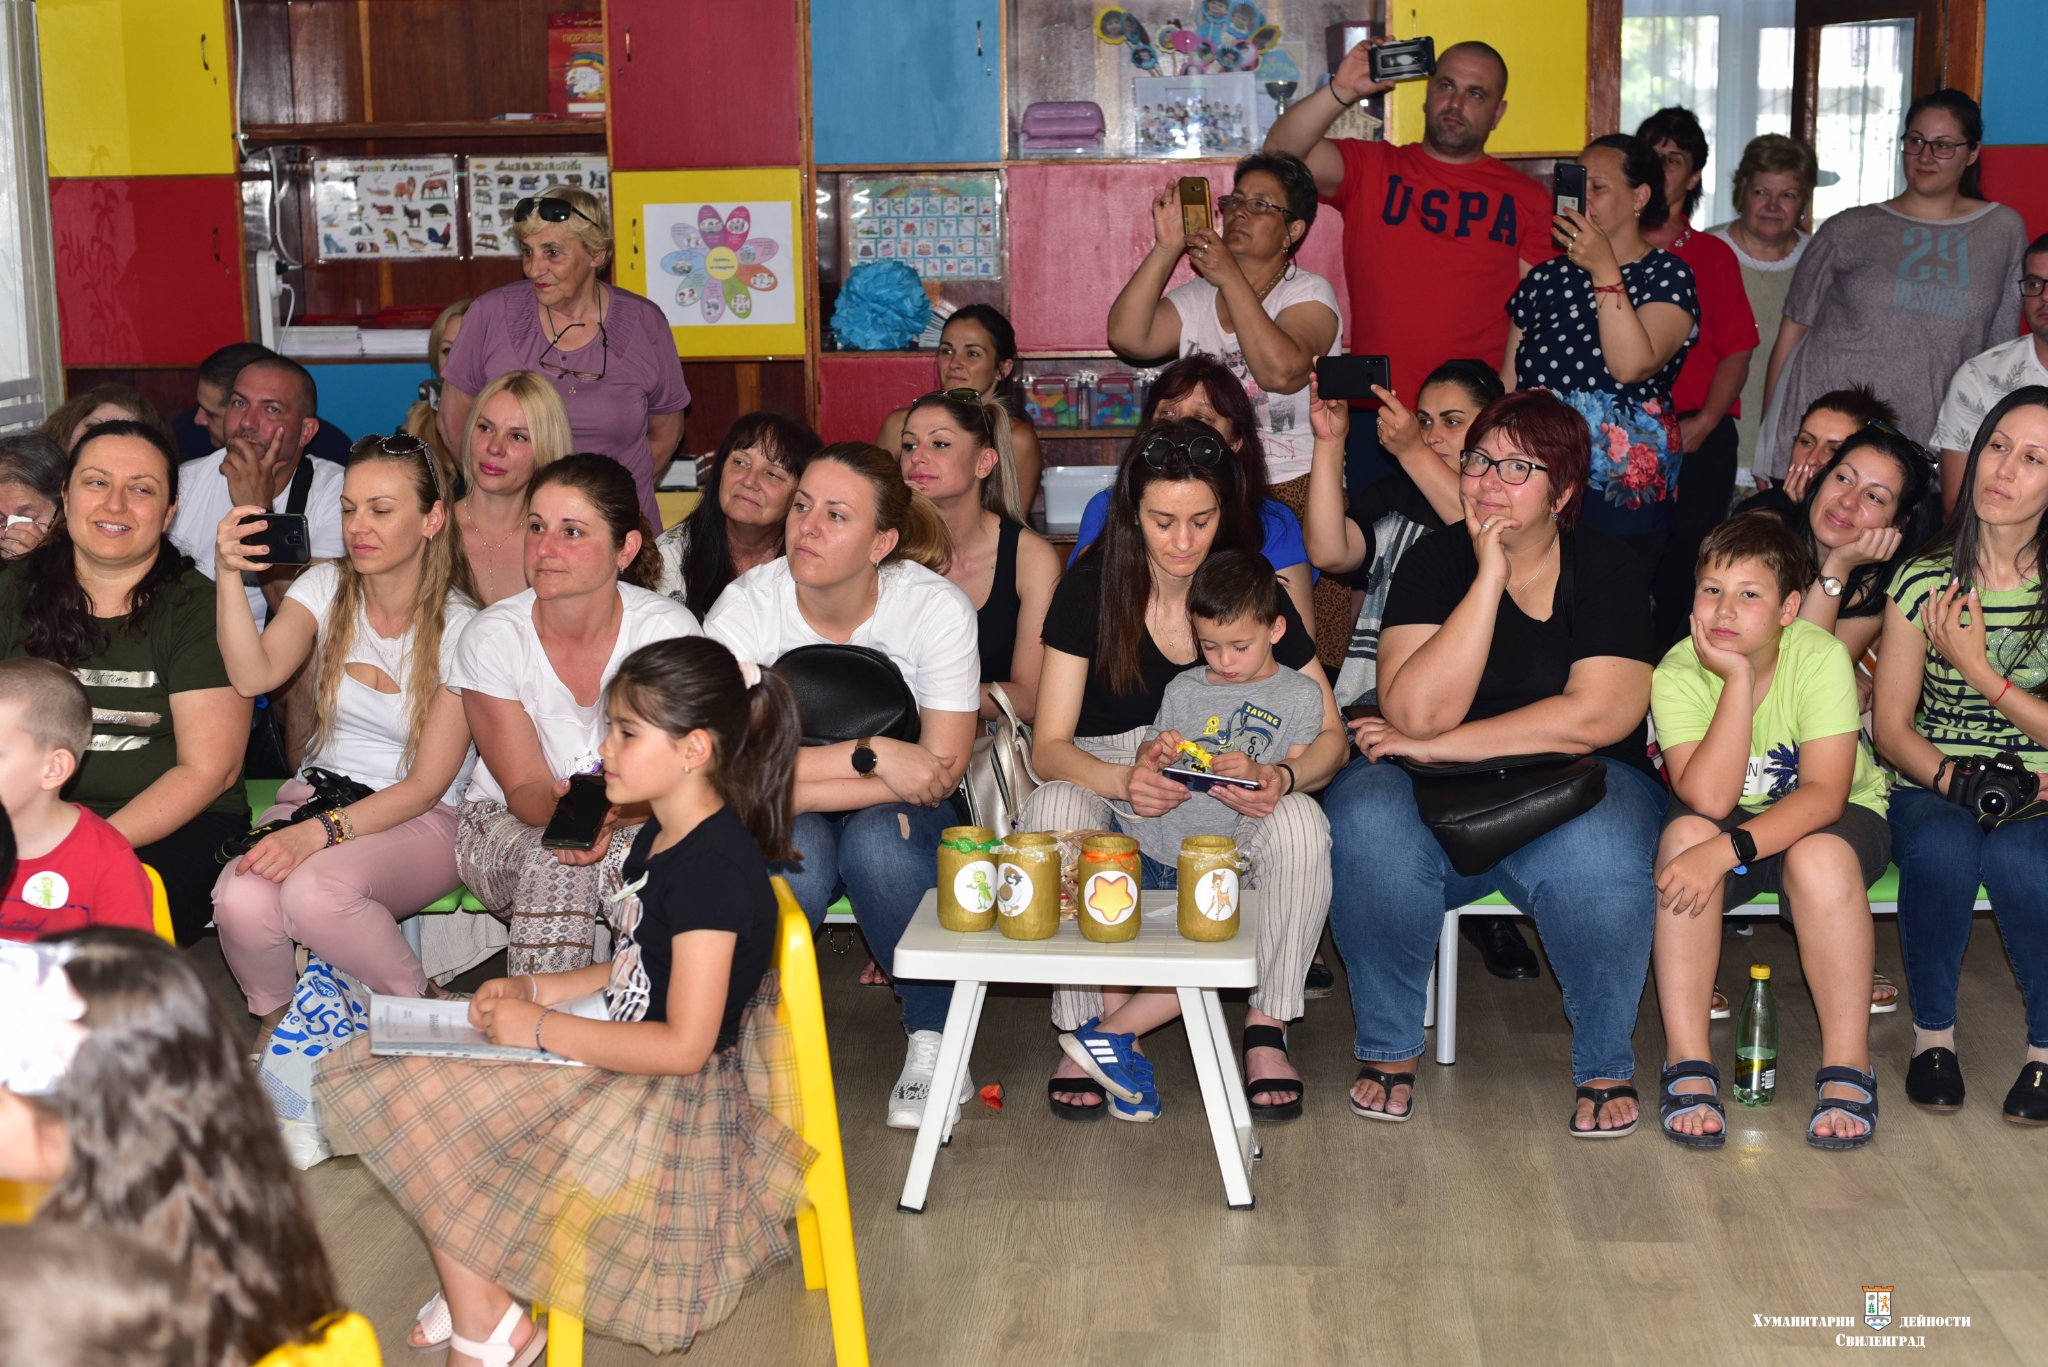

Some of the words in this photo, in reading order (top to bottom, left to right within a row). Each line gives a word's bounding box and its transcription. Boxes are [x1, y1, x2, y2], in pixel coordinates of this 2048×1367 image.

[1381, 174, 1518, 248] USPA
[1898, 226, 1969, 289] 29
[1246, 705, 1279, 726] SAVING
[1996, 762, 2014, 771] Nikon
[295, 985, 355, 1038] use
